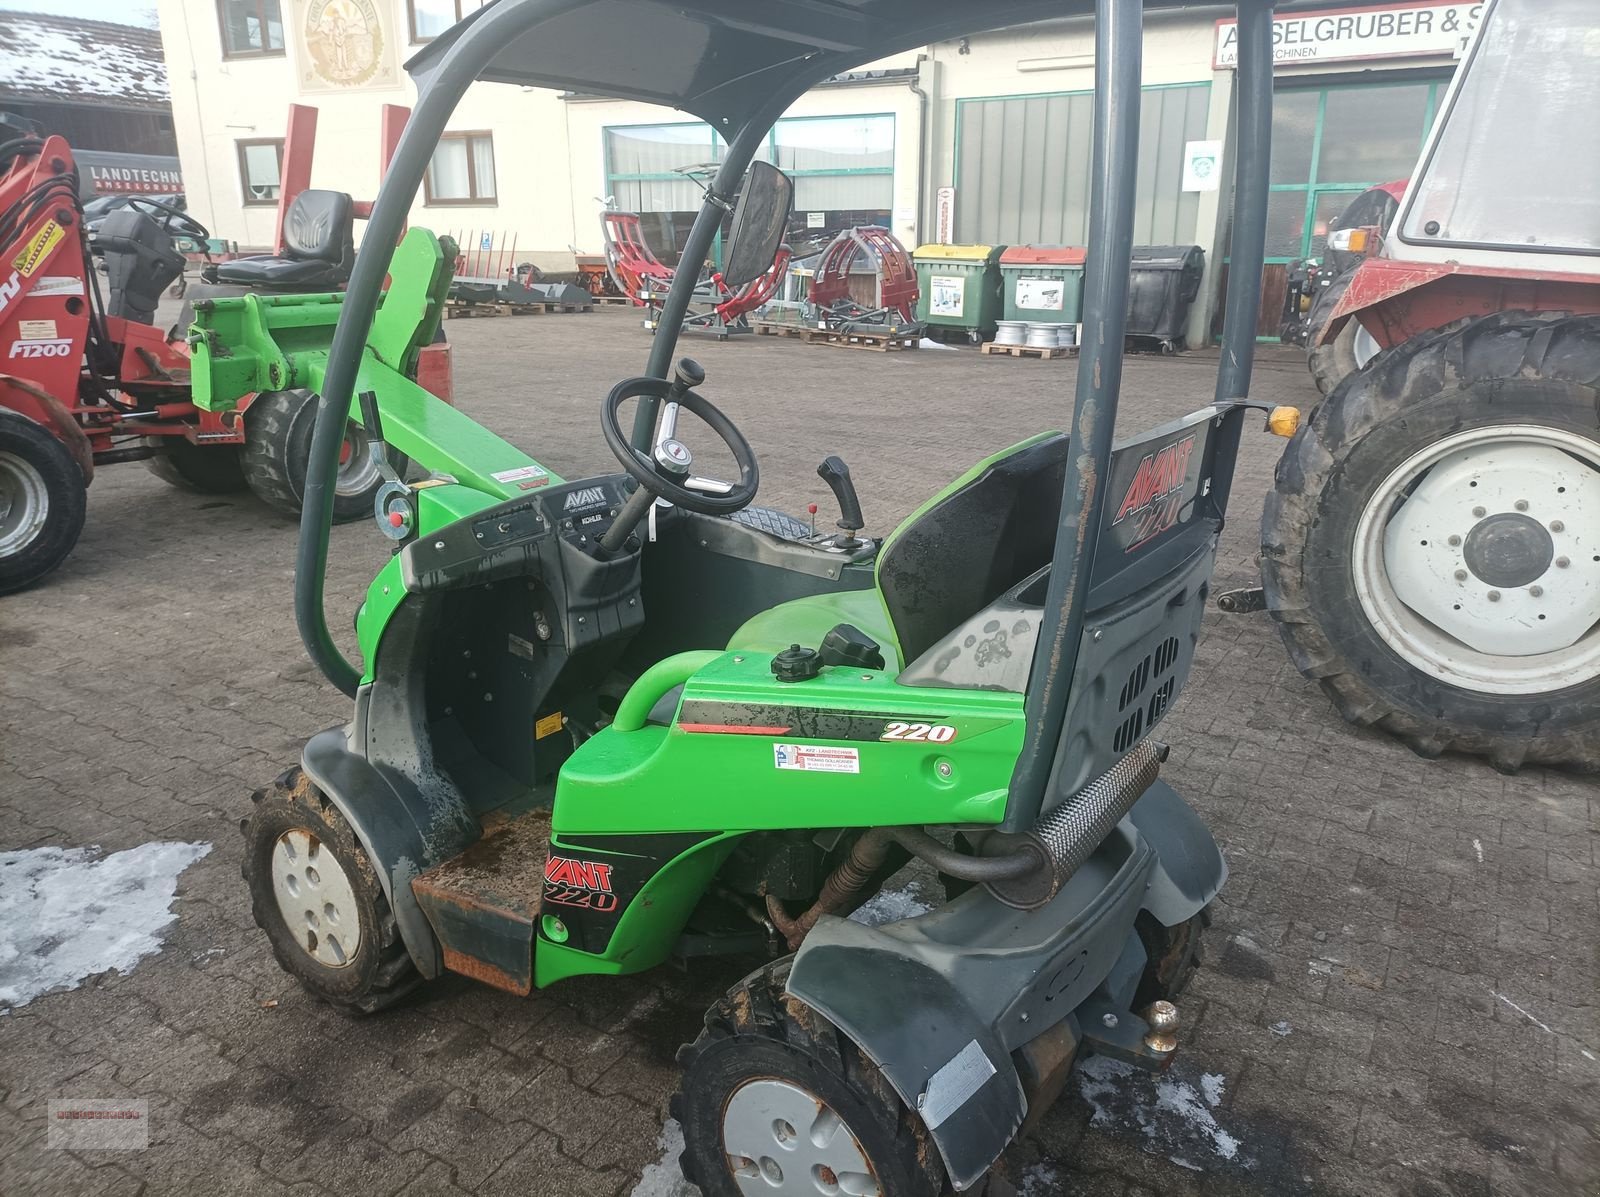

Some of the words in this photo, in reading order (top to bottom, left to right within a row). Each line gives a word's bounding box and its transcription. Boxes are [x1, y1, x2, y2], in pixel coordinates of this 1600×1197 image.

[1223, 10, 1434, 48] ASELGRUBER
[90, 166, 183, 183] LANDTECHN
[9, 338, 73, 358] F1200
[1112, 434, 1196, 526] AVANT
[563, 486, 607, 510] AVANT
[582, 514, 602, 525] KOHLER
[880, 722, 957, 743] 220
[544, 856, 612, 892] VANT
[543, 881, 618, 911] 220
